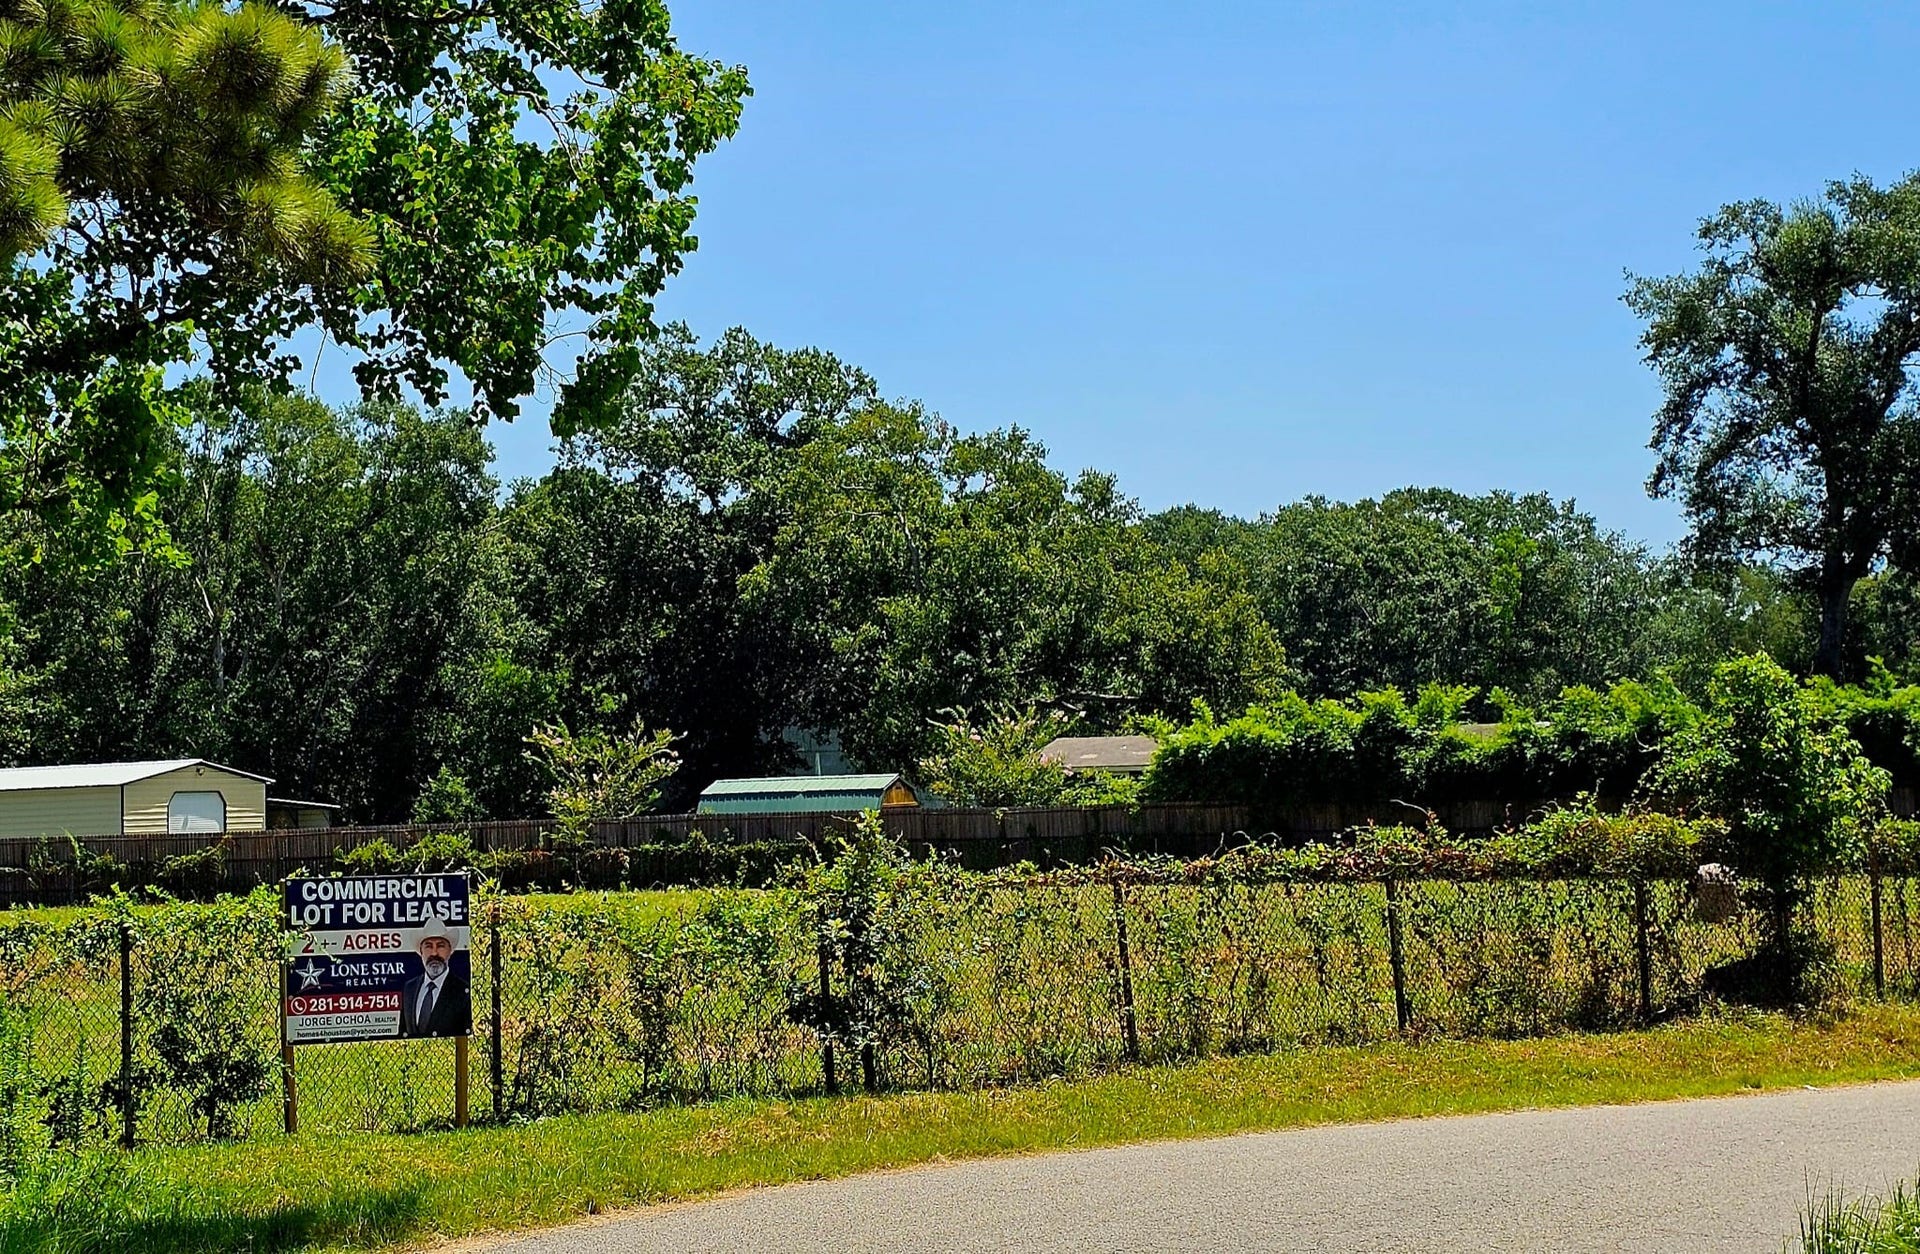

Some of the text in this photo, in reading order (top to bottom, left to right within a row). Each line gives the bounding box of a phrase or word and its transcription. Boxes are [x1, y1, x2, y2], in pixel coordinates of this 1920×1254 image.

[302, 879, 449, 901] COMMERCIAL
[291, 900, 462, 925] LOT FOR LEASE
[343, 933, 402, 950] ACRES
[331, 963, 405, 977] LONE STAR
[346, 978, 386, 986] REALTY
[310, 995, 399, 1011] 281-914-7514
[299, 1016, 332, 1027] JORGE
[336, 1015, 370, 1025] OCHOA
[297, 1027, 391, 1037] homes4houston@yahoo.com
